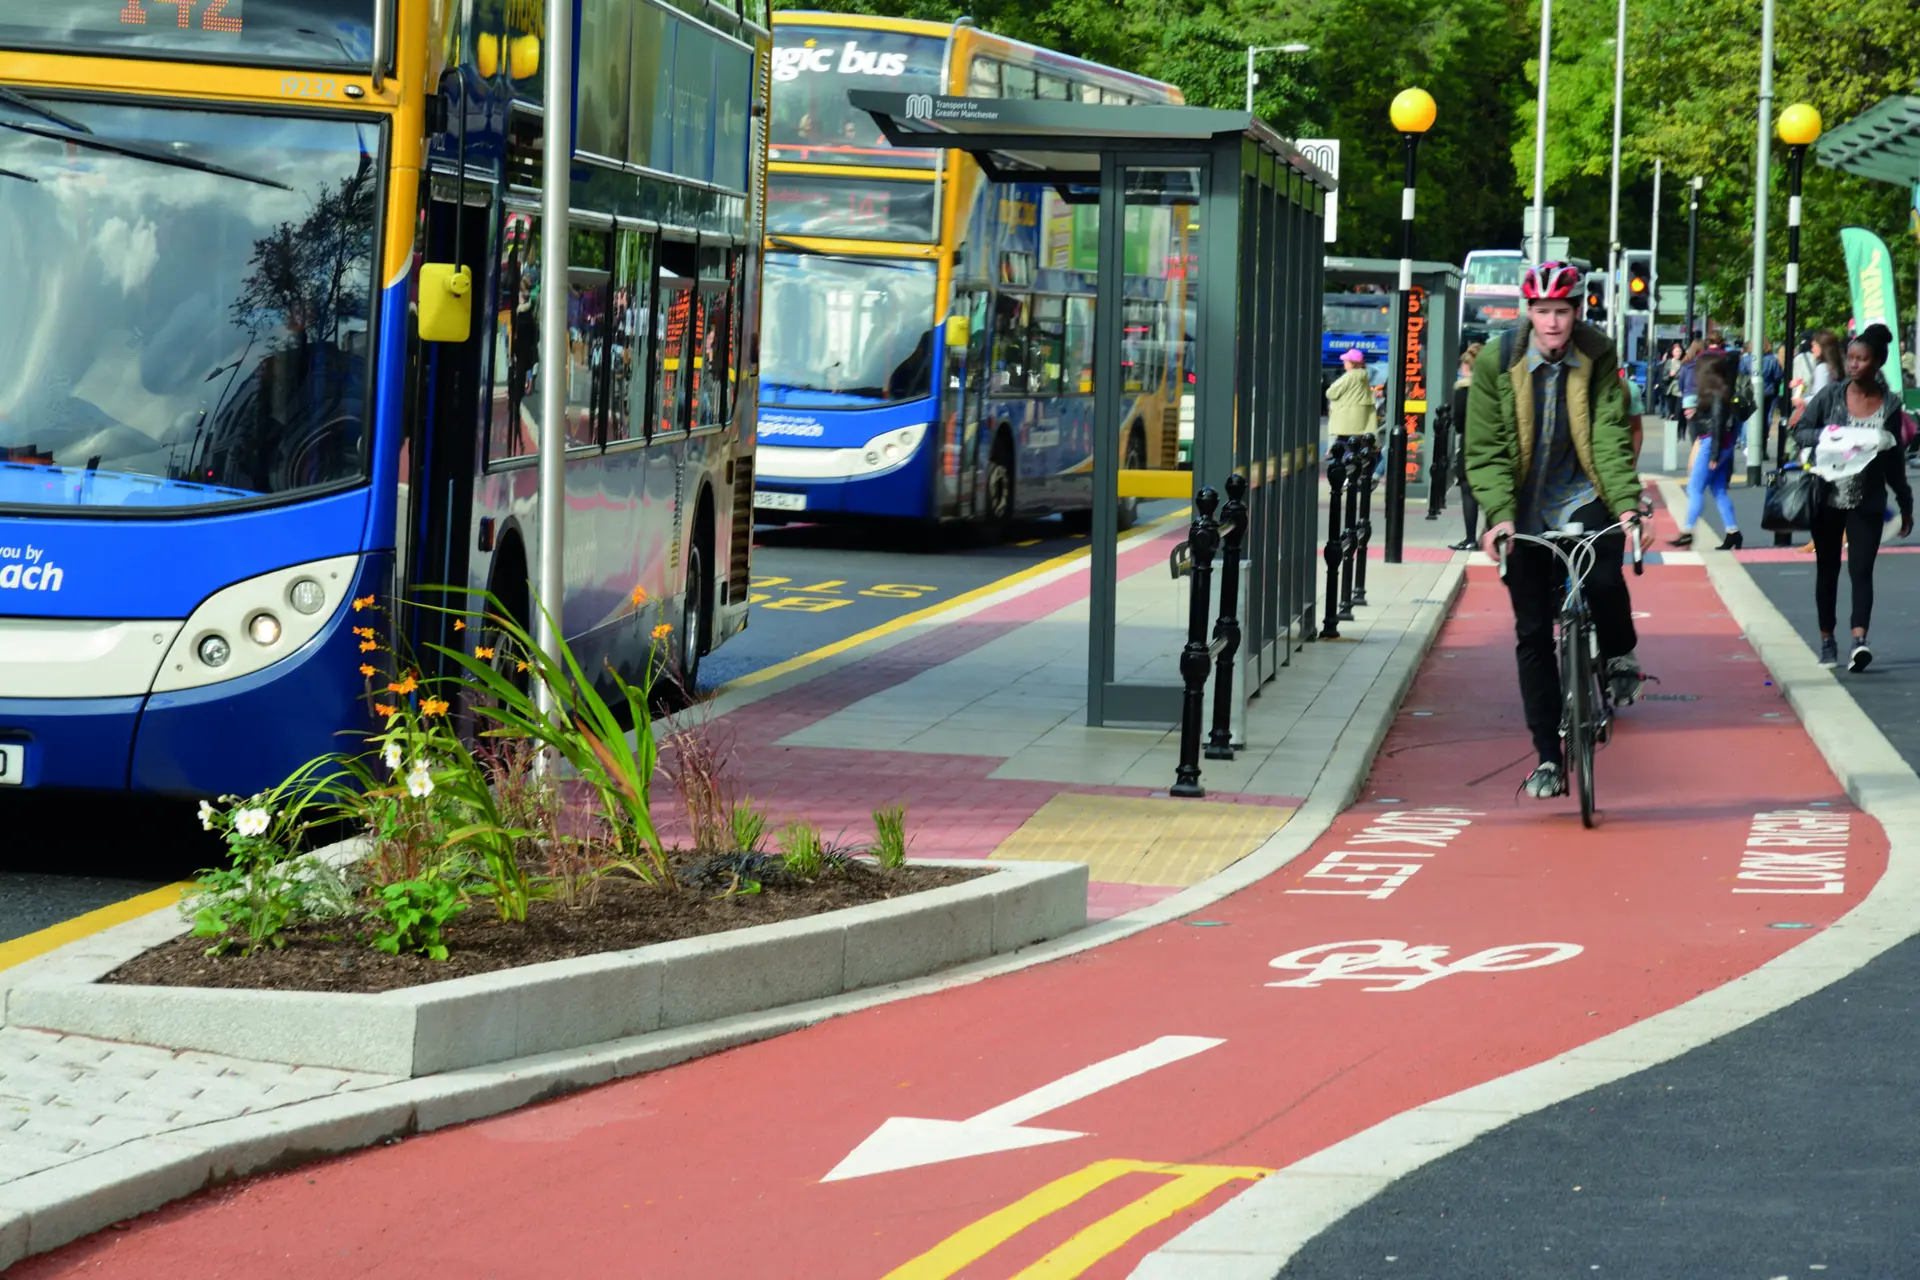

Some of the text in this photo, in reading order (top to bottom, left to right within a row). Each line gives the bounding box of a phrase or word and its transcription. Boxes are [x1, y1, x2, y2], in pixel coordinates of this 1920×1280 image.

[837, 41, 908, 76] bus
[281, 76, 336, 99] 19232
[935, 109, 998, 119] Greater Manchester
[936, 100, 978, 110] Transport for
[1406, 317, 1424, 382] Dutch!
[25, 544, 44, 565] by
[1282, 811, 1488, 900] LOOK LEFT
[1732, 812, 1851, 894] LOOK RIGHT
